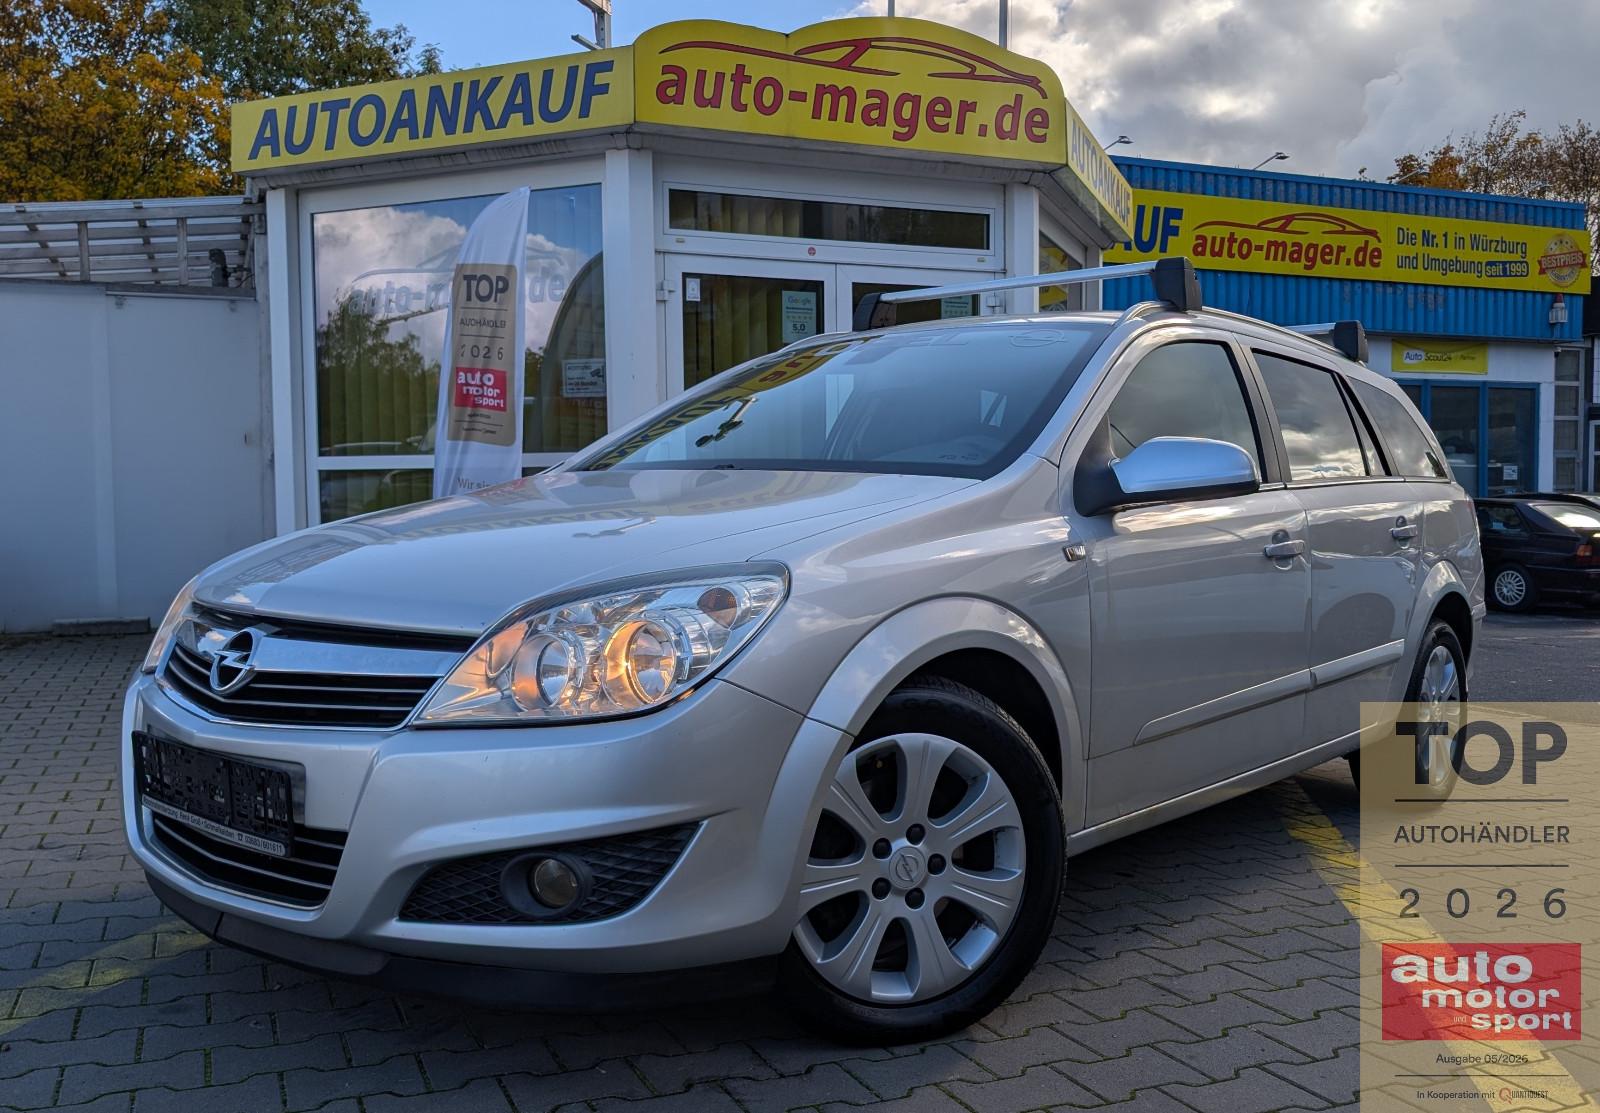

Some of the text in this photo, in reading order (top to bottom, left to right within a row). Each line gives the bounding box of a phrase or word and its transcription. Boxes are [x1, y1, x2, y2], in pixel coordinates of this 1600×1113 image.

[248, 60, 614, 160] AUTOANKAUF
[656, 64, 1050, 144] auto-mager.de
[1071, 119, 1131, 227] AUTOANKAUF
[1112, 204, 1184, 254] UF
[1397, 227, 1527, 258] Die Nr. 1 in Würzburg
[1192, 231, 1382, 270] auto-mager.de
[1541, 252, 1583, 269] BESTPREIS
[1396, 253, 1528, 278] und Umgebung seit 1999
[463, 274, 509, 303] TOP
[1405, 351, 1422, 361] Auto
[457, 371, 495, 386] auto
[463, 385, 500, 398] motor
[475, 396, 504, 408] sport
[458, 477, 473, 489] Wir
